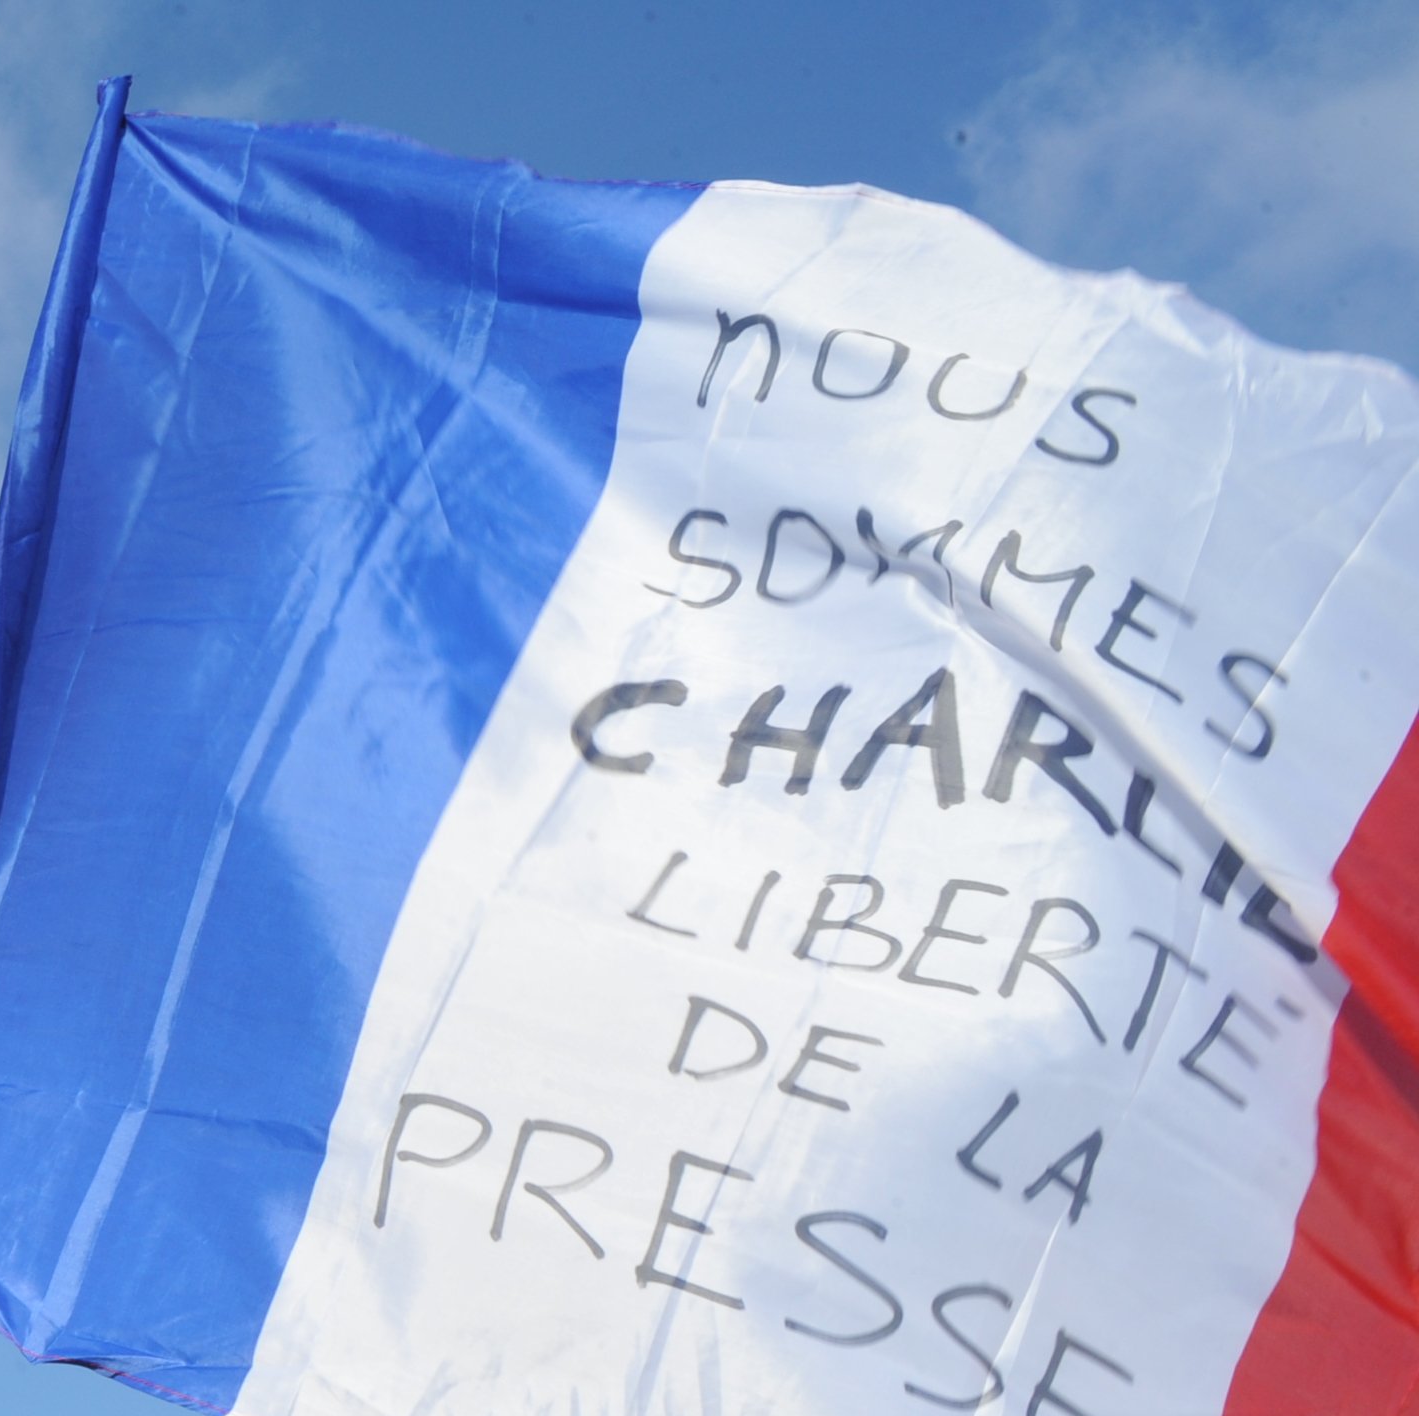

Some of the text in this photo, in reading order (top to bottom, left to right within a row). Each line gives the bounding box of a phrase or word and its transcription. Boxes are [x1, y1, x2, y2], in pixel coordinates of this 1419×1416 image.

[641, 507, 1292, 762] SOMMES
[569, 667, 1319, 965] CHARLIE
[670, 996, 1104, 1225] DE LA
